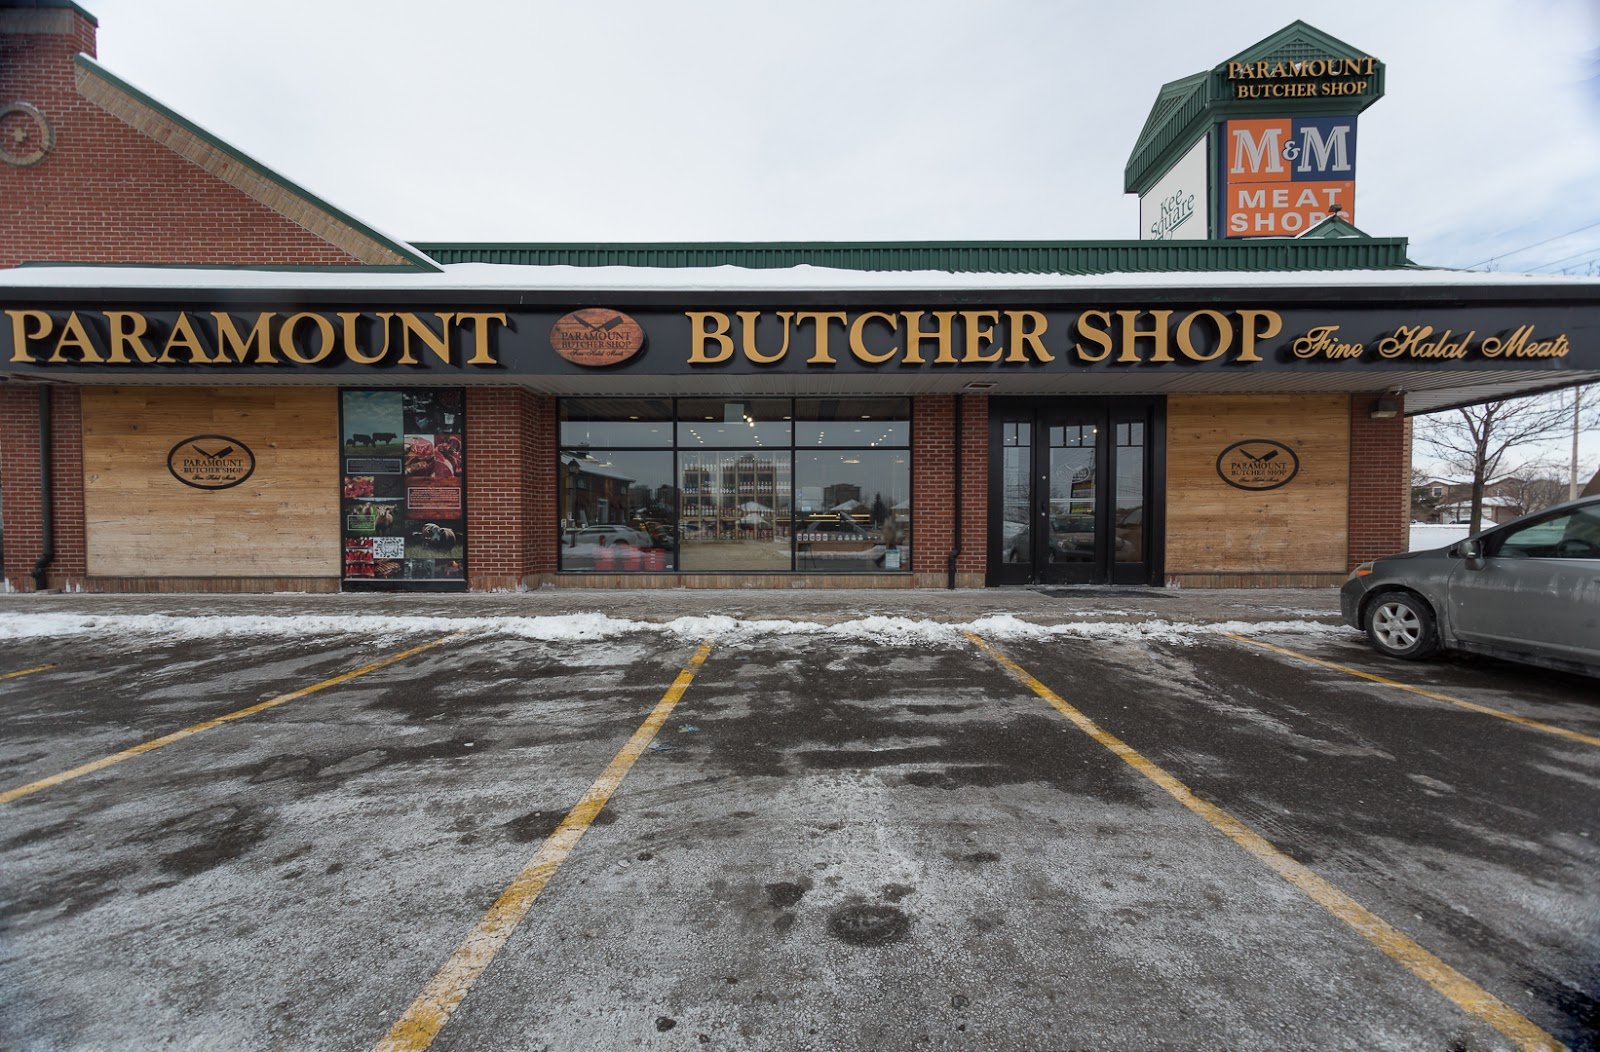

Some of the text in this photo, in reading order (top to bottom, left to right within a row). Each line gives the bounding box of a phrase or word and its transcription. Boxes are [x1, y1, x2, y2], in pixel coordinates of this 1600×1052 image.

[1228, 57, 1377, 79] PARAMOUNT
[1238, 81, 1367, 98] BUTCHER SHOP
[1230, 125, 1351, 174] M&M
[1160, 189, 1183, 219] Kee
[1238, 188, 1342, 209] MEAT
[4, 308, 508, 365] PARAMOUNT
[561, 331, 632, 341] PARAMOUNT
[561, 341, 632, 349] BUTCHER SHOP
[685, 308, 1283, 365] BUTCHER SHOP
[1293, 324, 1570, 359] Fine Halal Meats
[183, 459, 243, 467] PARAMOUNT
[1231, 462, 1287, 470] PARAMOUNT
